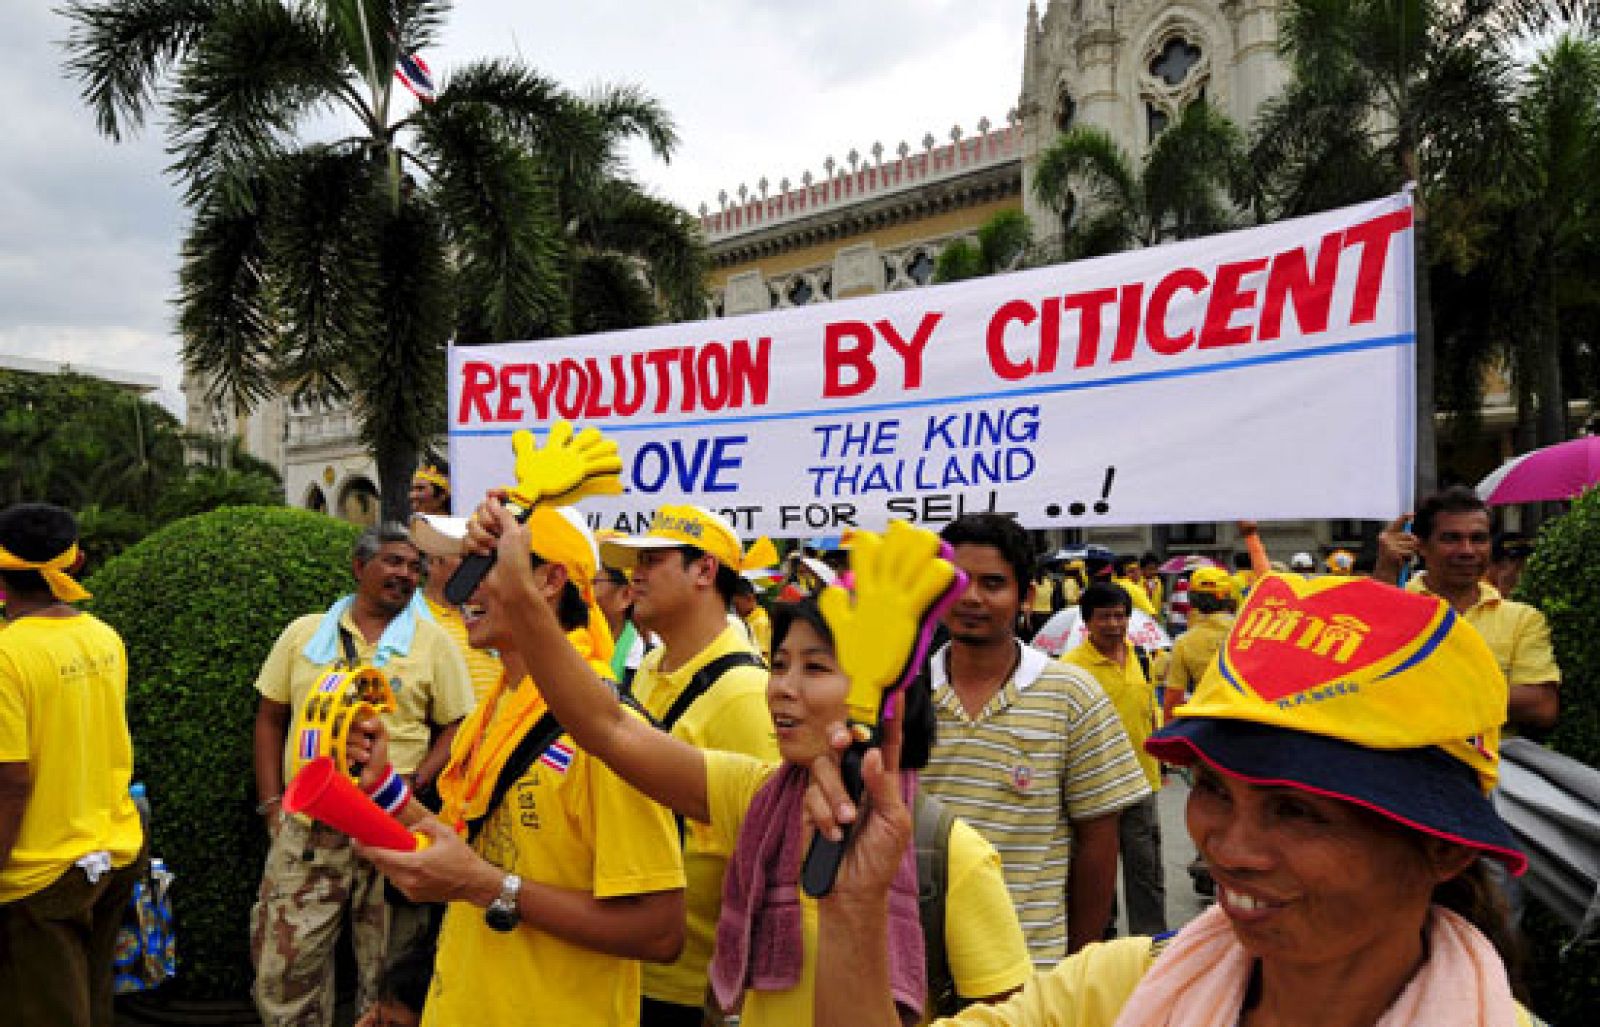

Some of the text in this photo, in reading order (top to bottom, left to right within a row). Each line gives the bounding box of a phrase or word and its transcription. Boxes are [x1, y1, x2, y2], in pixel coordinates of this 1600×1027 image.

[457, 206, 1412, 424] REVOLUTION BY CITICENT
[813, 404, 1041, 458] THE KING
[622, 435, 748, 493] OVE
[807, 447, 1037, 497] THAILAND
[781, 503, 858, 529] FOR
